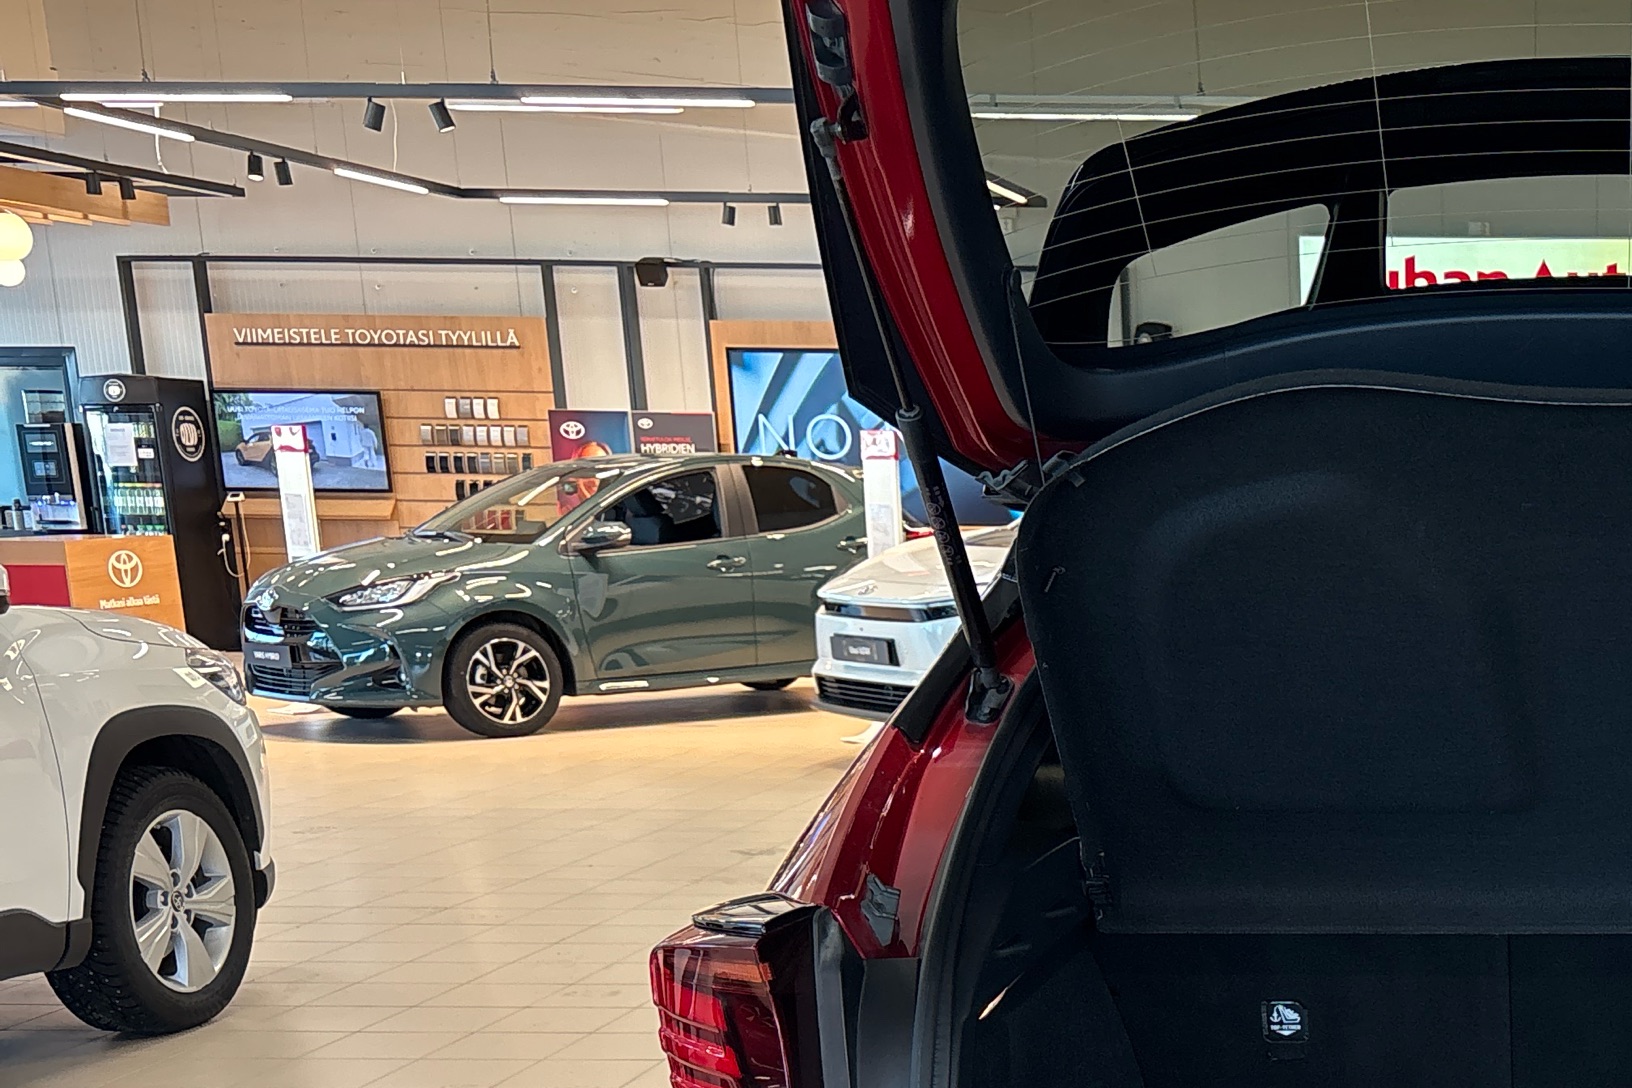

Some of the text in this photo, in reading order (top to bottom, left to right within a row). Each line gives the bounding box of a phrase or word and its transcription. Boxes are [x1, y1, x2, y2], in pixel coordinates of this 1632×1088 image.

[233, 327, 520, 347] VIIMEISTELE TOYOTASI TYYLILLÄ
[640, 443, 696, 454] HYBRIDIEN
